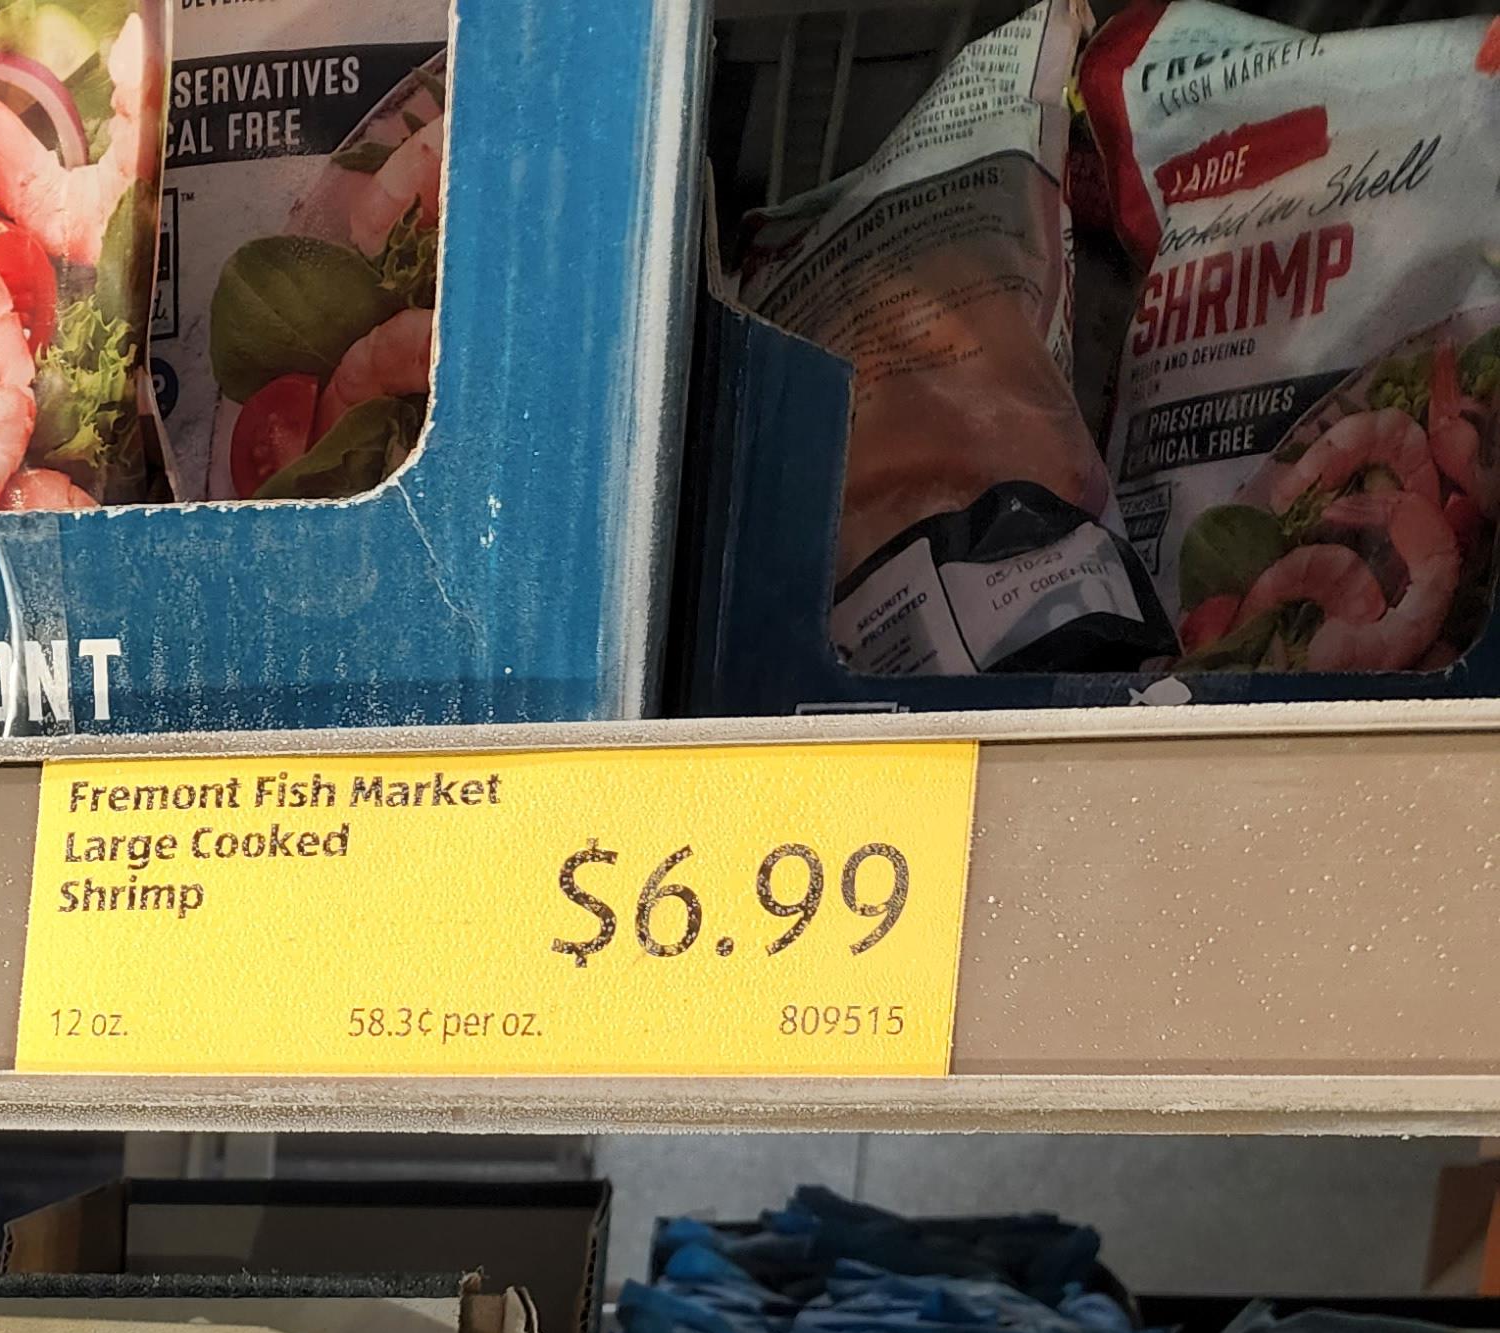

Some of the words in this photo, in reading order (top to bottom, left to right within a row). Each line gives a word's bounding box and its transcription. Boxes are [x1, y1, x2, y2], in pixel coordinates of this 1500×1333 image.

[169, 56, 361, 109] SERVATIVES
[229, 110, 302, 150] FREE
[1169, 145, 1250, 196] LARGE
[1309, 134, 1442, 217] Shell
[1133, 223, 1354, 357] SHRIMP
[1191, 338, 1256, 367] DEVEINED
[1148, 385, 1297, 437] PRESERVATIVES
[1209, 424, 1256, 455] FREE
[69, 777, 242, 813] Fremont
[255, 772, 336, 808] Fish
[349, 772, 503, 808] Market
[64, 830, 178, 870] Large
[191, 823, 351, 860] Cooked
[58, 875, 205, 919] Shrimp
[551, 838, 911, 968] $6.99
[50, 1009, 81, 1037] 12
[91, 1011, 129, 1037] oz.
[348, 1006, 433, 1038] 58.3¢
[442, 1009, 491, 1044] per
[501, 1010, 543, 1038] oz.
[778, 1004, 906, 1036] 809515
